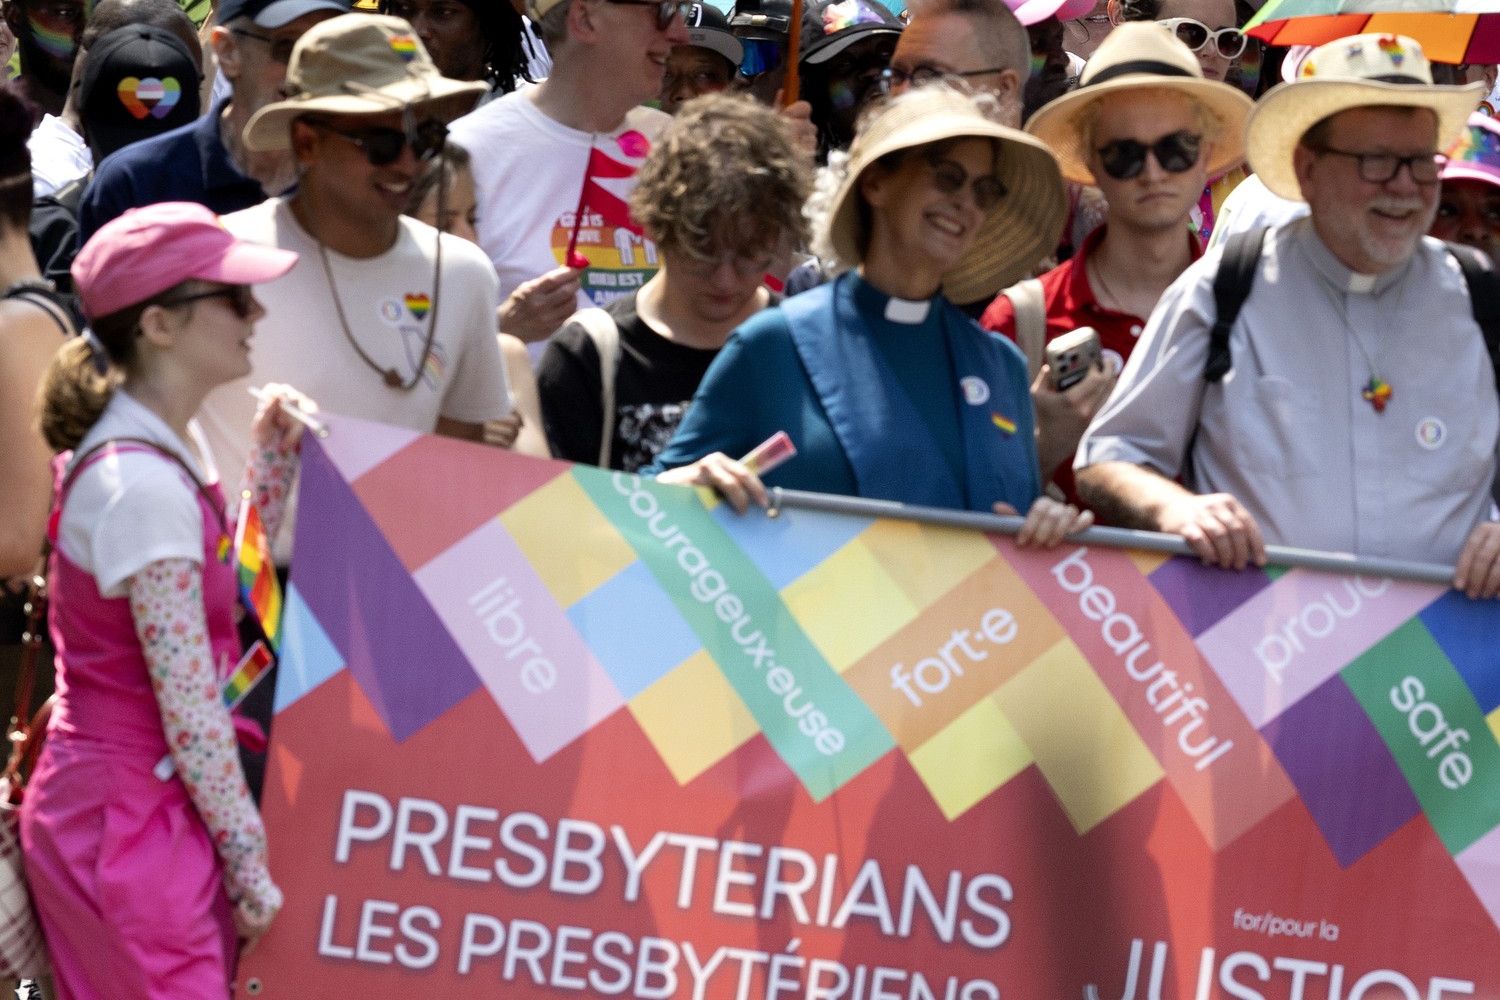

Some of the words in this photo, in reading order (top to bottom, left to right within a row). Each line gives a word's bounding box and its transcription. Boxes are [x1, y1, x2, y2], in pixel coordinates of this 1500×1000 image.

[468, 576, 557, 694] libre
[890, 607, 1018, 708] fort·e
[1051, 547, 1234, 771] beautiful
[1389, 675, 1473, 789] safe
[335, 788, 1014, 948] PRESBYTERIANS
[1233, 908, 1317, 938] for/pour
[1319, 920, 1339, 942] la
[318, 894, 441, 969] LES
